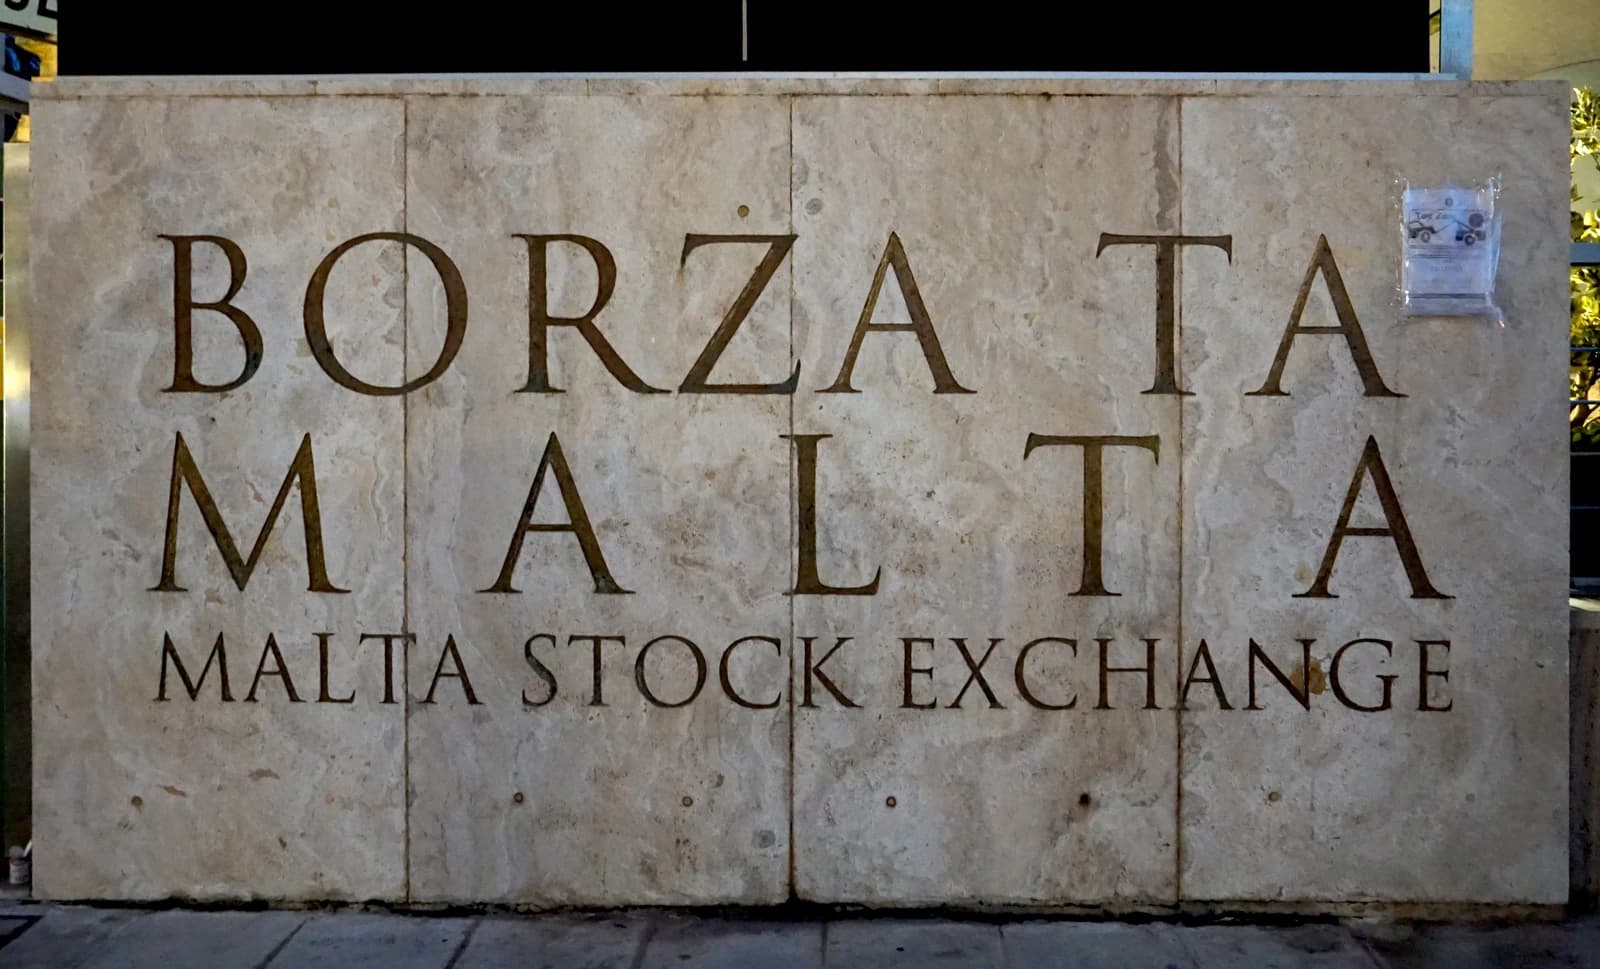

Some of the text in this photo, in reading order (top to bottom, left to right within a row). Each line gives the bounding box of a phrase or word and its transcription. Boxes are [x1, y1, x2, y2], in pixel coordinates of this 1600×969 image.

[1096, 232, 1408, 398] TA
[147, 431, 1455, 600] MALTA
[153, 631, 1453, 712] MALTA STOCK EXCHANGE
